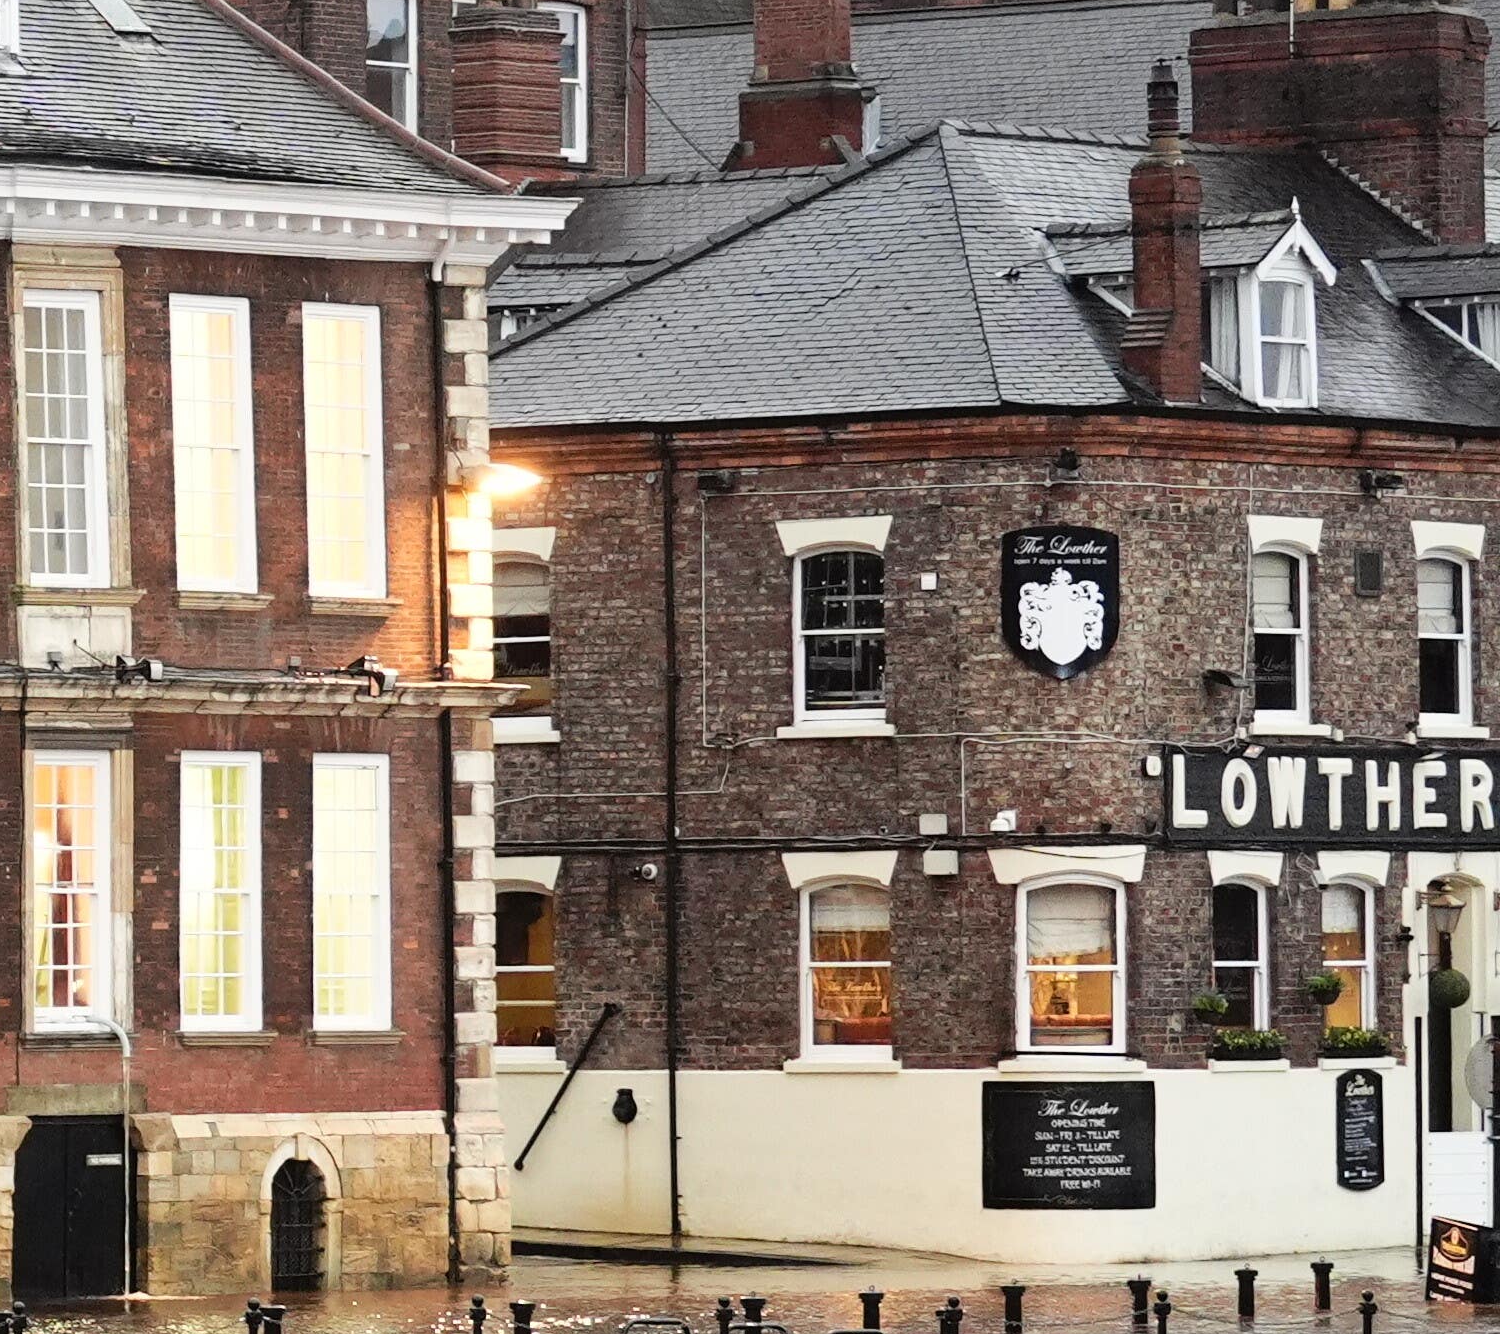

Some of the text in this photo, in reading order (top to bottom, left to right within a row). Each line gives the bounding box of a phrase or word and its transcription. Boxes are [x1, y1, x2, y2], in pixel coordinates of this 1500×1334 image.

[1013, 534, 1108, 555] The Lowther
[1171, 753, 1495, 833] LOWTHER
[1037, 1098, 1120, 1117] The Lowther
[1060, 1180, 1080, 1189] FREE
